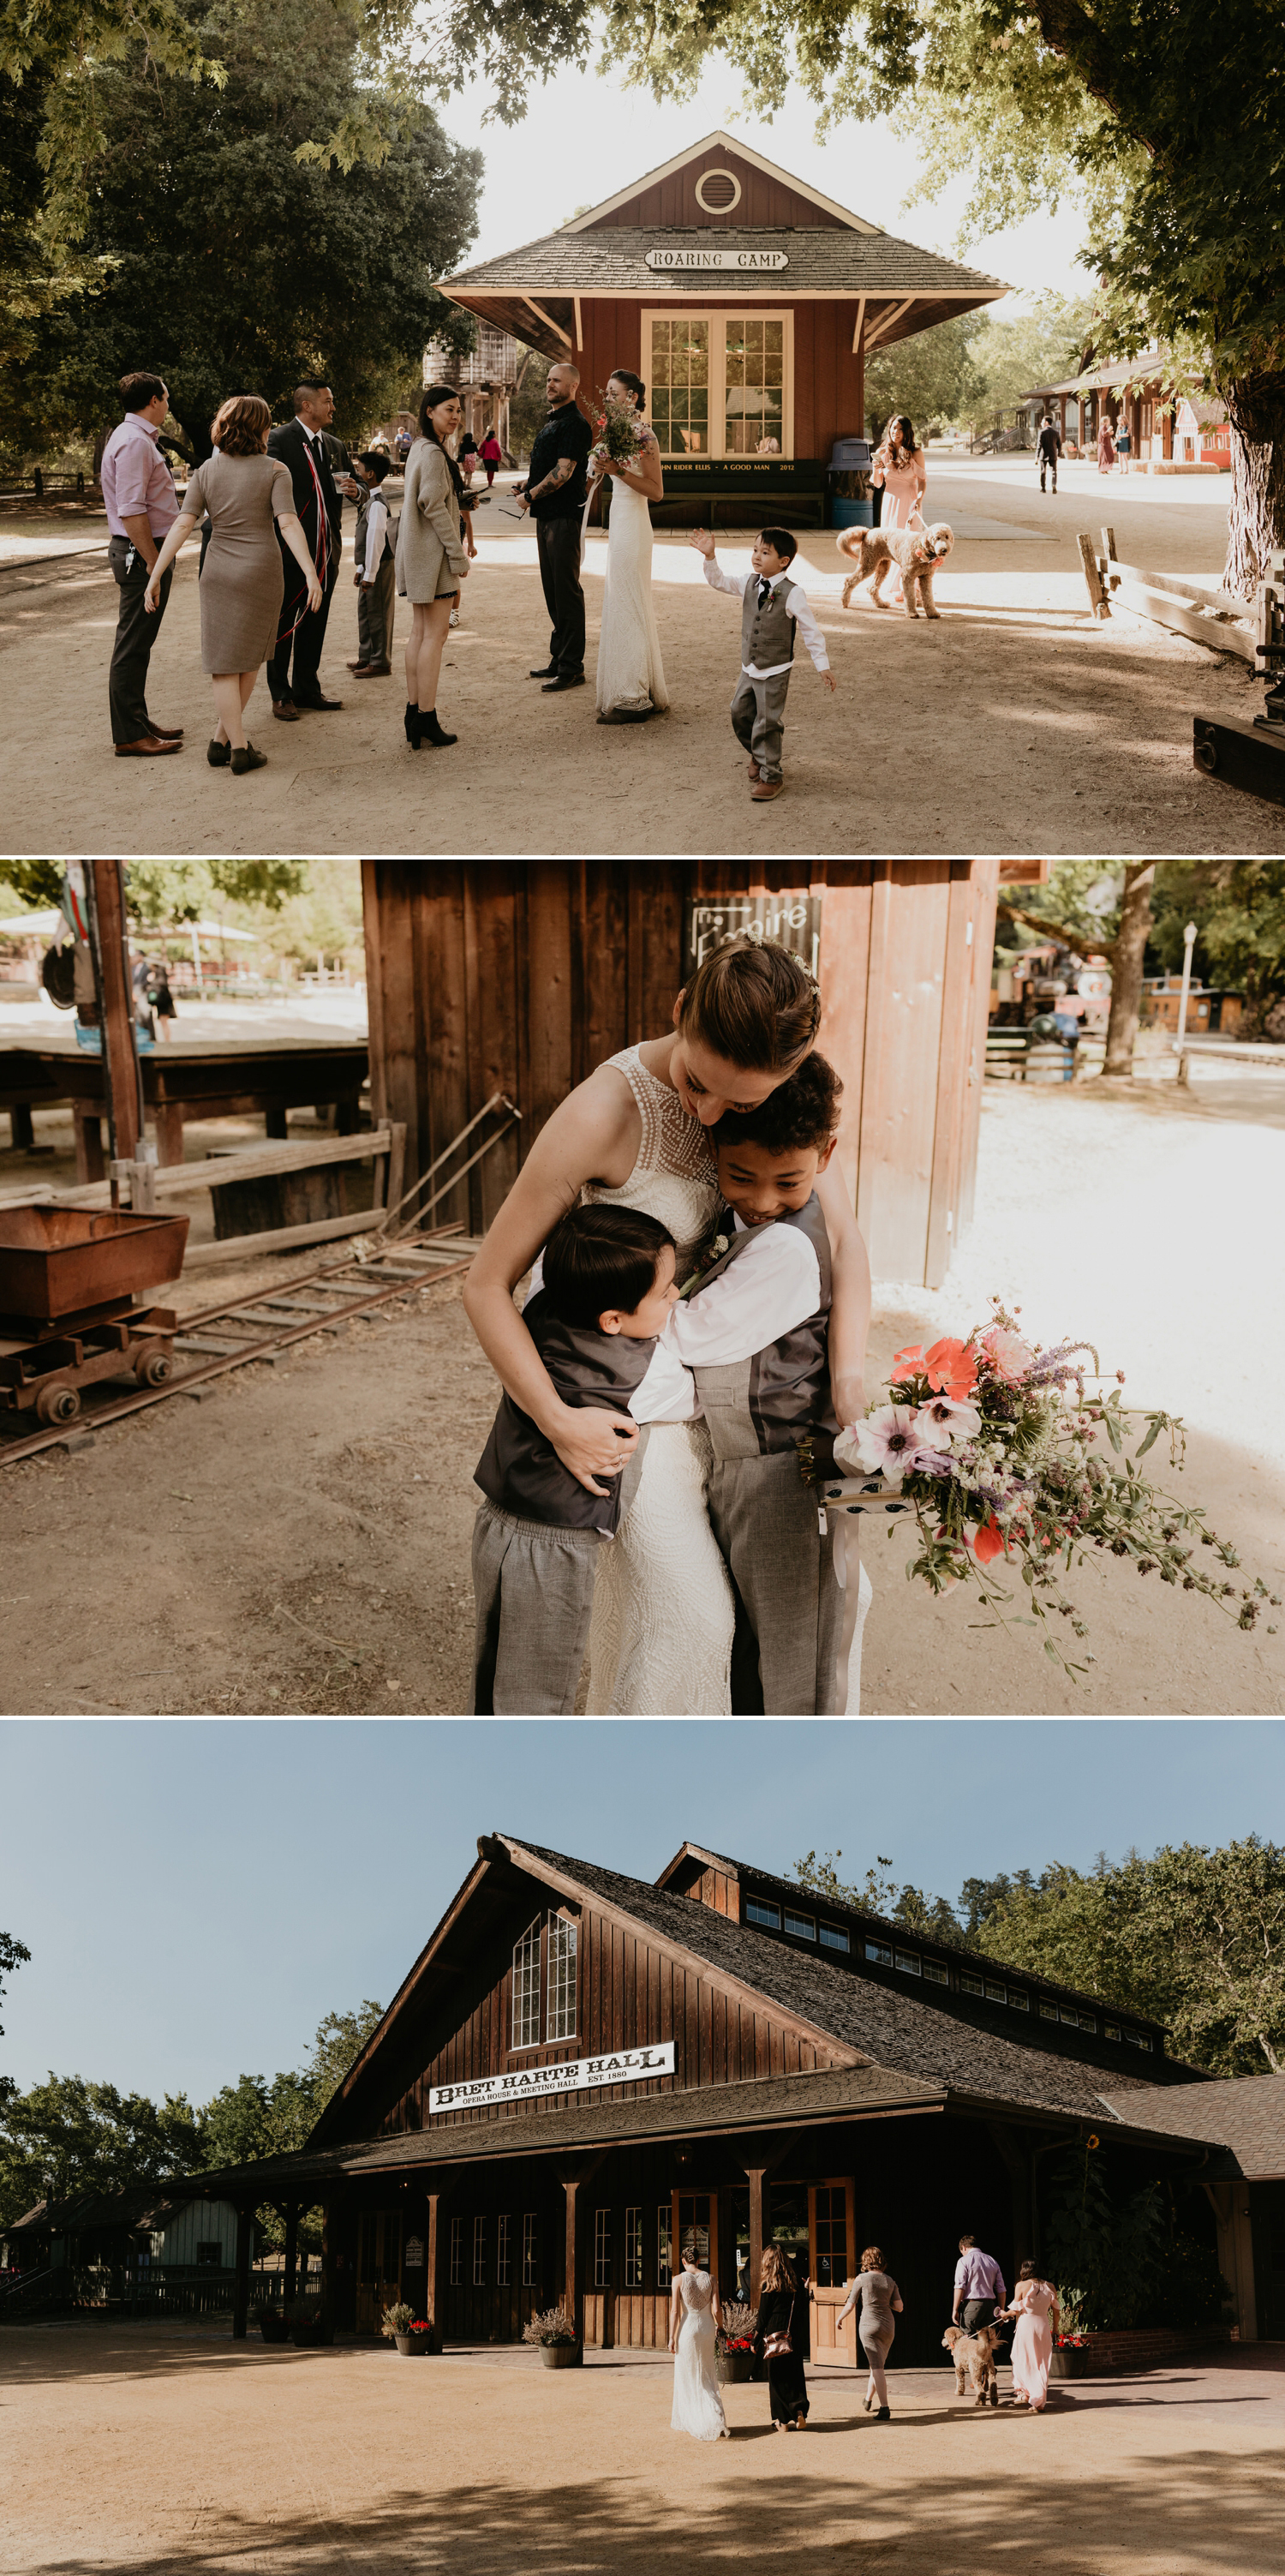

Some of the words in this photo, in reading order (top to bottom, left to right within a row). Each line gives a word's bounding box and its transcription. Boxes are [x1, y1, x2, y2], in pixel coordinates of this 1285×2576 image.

[654, 253, 722, 266] ROARING
[738, 254, 781, 267] CAMP
[501, 2064, 579, 2089] HARTE
[587, 2050, 666, 2074] HALL
[588, 2075, 605, 2083] EST.
[607, 2070, 627, 2080] 1880
[463, 2095, 486, 2105] OPERA
[487, 2091, 511, 2100] HOUSE
[521, 2082, 556, 2094] MEETING
[558, 2079, 578, 2088] HALL
